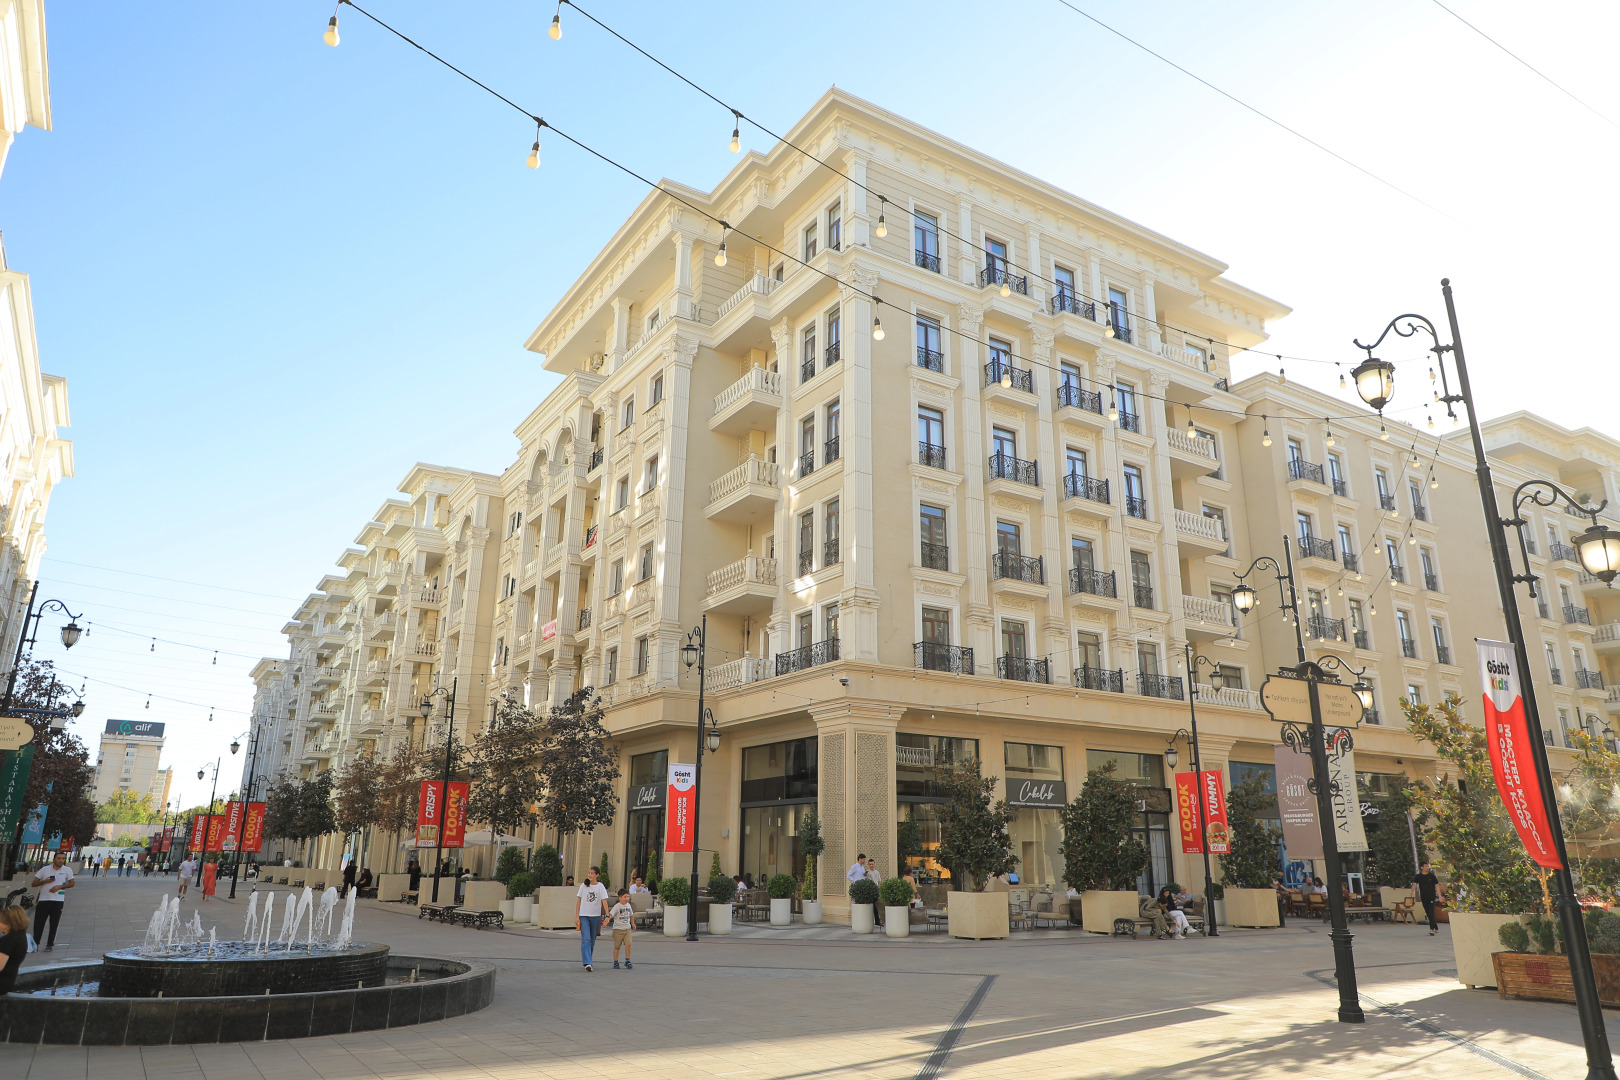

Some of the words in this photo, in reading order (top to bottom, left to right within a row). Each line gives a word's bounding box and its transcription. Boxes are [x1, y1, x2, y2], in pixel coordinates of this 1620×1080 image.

[1491, 676, 1508, 691] Kids
[426, 784, 436, 818] CRISPY
[1206, 772, 1219, 816] YUMMY
[1344, 774, 1354, 813] GROUP
[1504, 724, 1520, 784] МАСТЕР
[1516, 788, 1547, 854] КЛАССЫ
[229, 802, 240, 832] POSITIVE
[245, 809, 258, 844] LOOOK
[446, 788, 460, 836] LOOOK
[1179, 784, 1193, 842] LOOOK
[1510, 792, 1528, 828] KIDS
[208, 819, 218, 846] LOOOK
